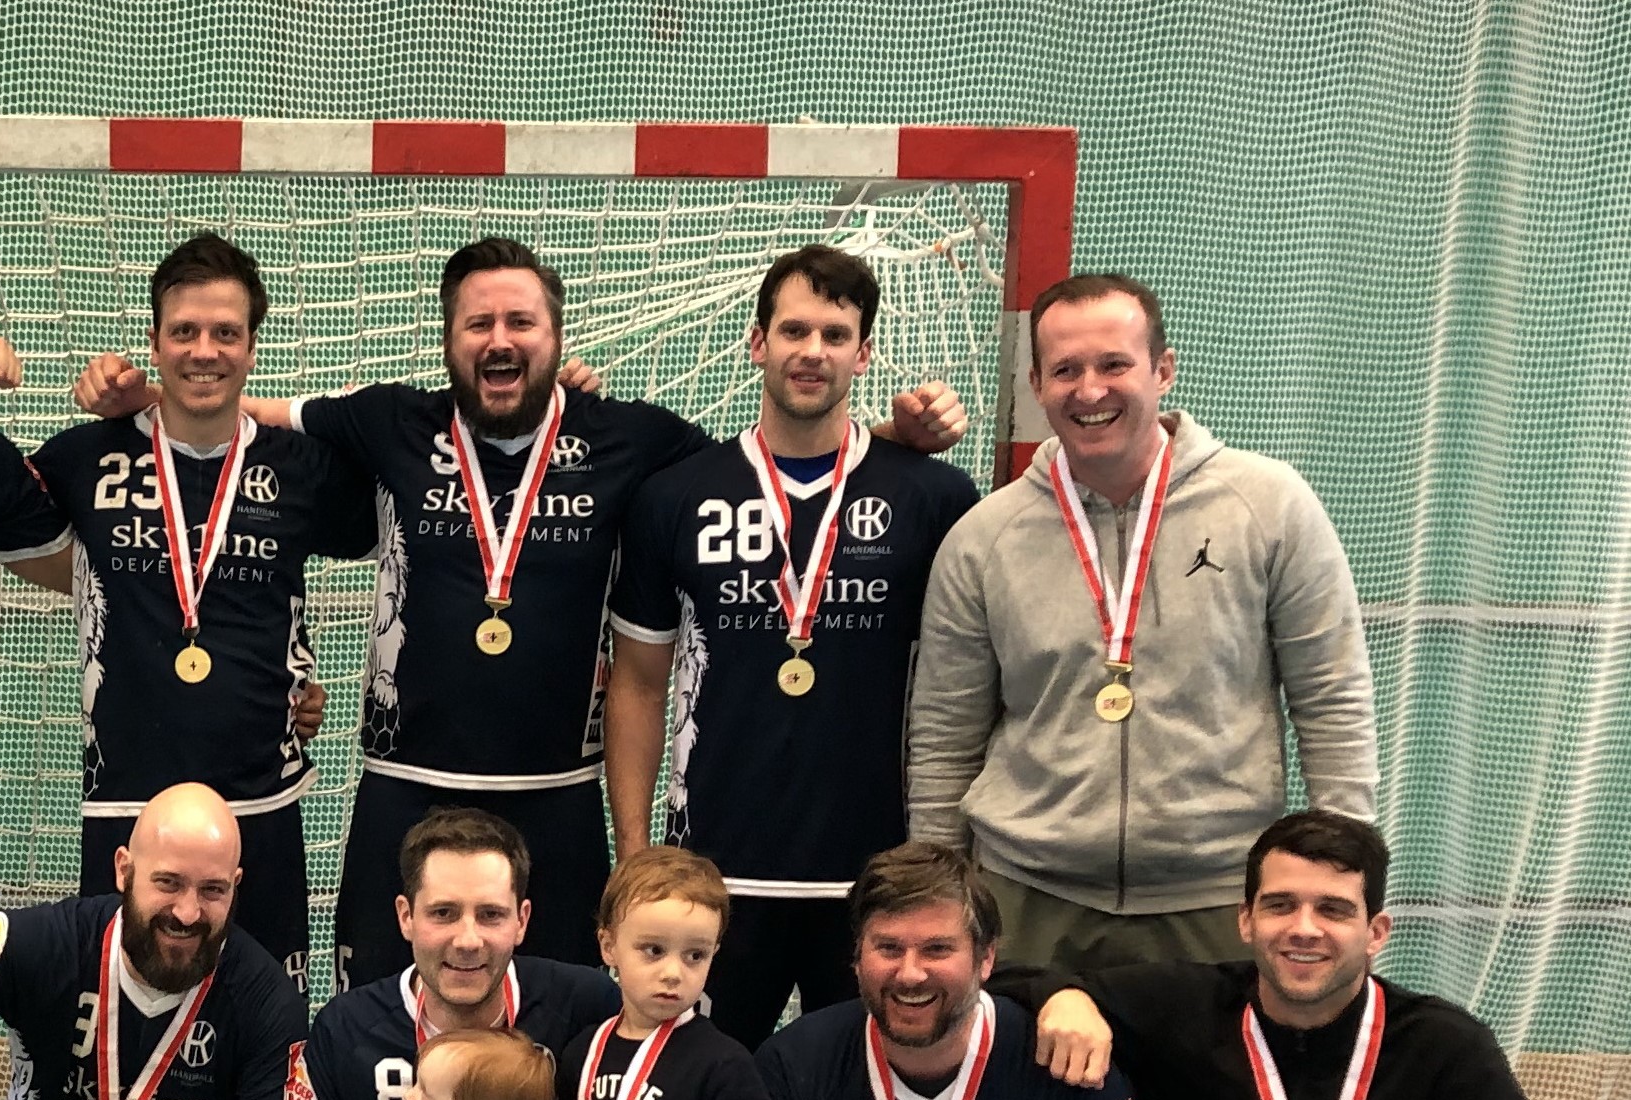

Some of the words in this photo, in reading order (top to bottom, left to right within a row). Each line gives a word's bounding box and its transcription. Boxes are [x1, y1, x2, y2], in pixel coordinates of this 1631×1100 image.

[93, 452, 163, 511] 23
[698, 498, 773, 563] 28
[719, 569, 889, 612] skyine
[718, 613, 885, 630] DEVELPMENT
